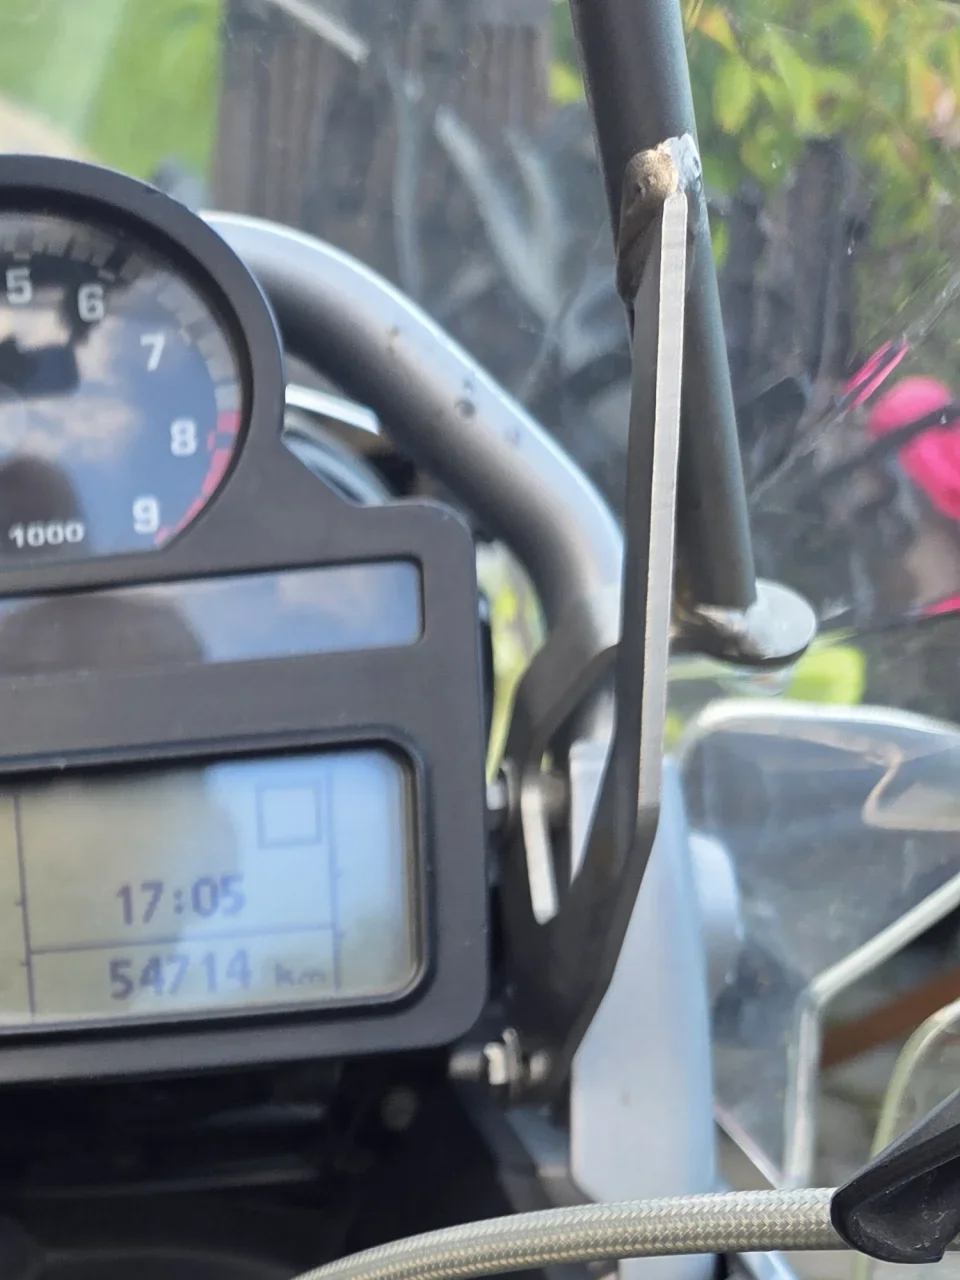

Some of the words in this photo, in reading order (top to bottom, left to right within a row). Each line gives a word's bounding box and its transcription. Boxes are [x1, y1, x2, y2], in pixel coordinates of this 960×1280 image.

[6, 269, 32, 303] 5
[78, 283, 104, 322] 6
[141, 333, 166, 371] 7
[171, 419, 196, 456] 8
[132, 497, 160, 533] 9
[9, 521, 85, 549] 1000
[116, 874, 246, 926] 17:05
[109, 949, 252, 1001] 54714
[275, 962, 326, 985] km
